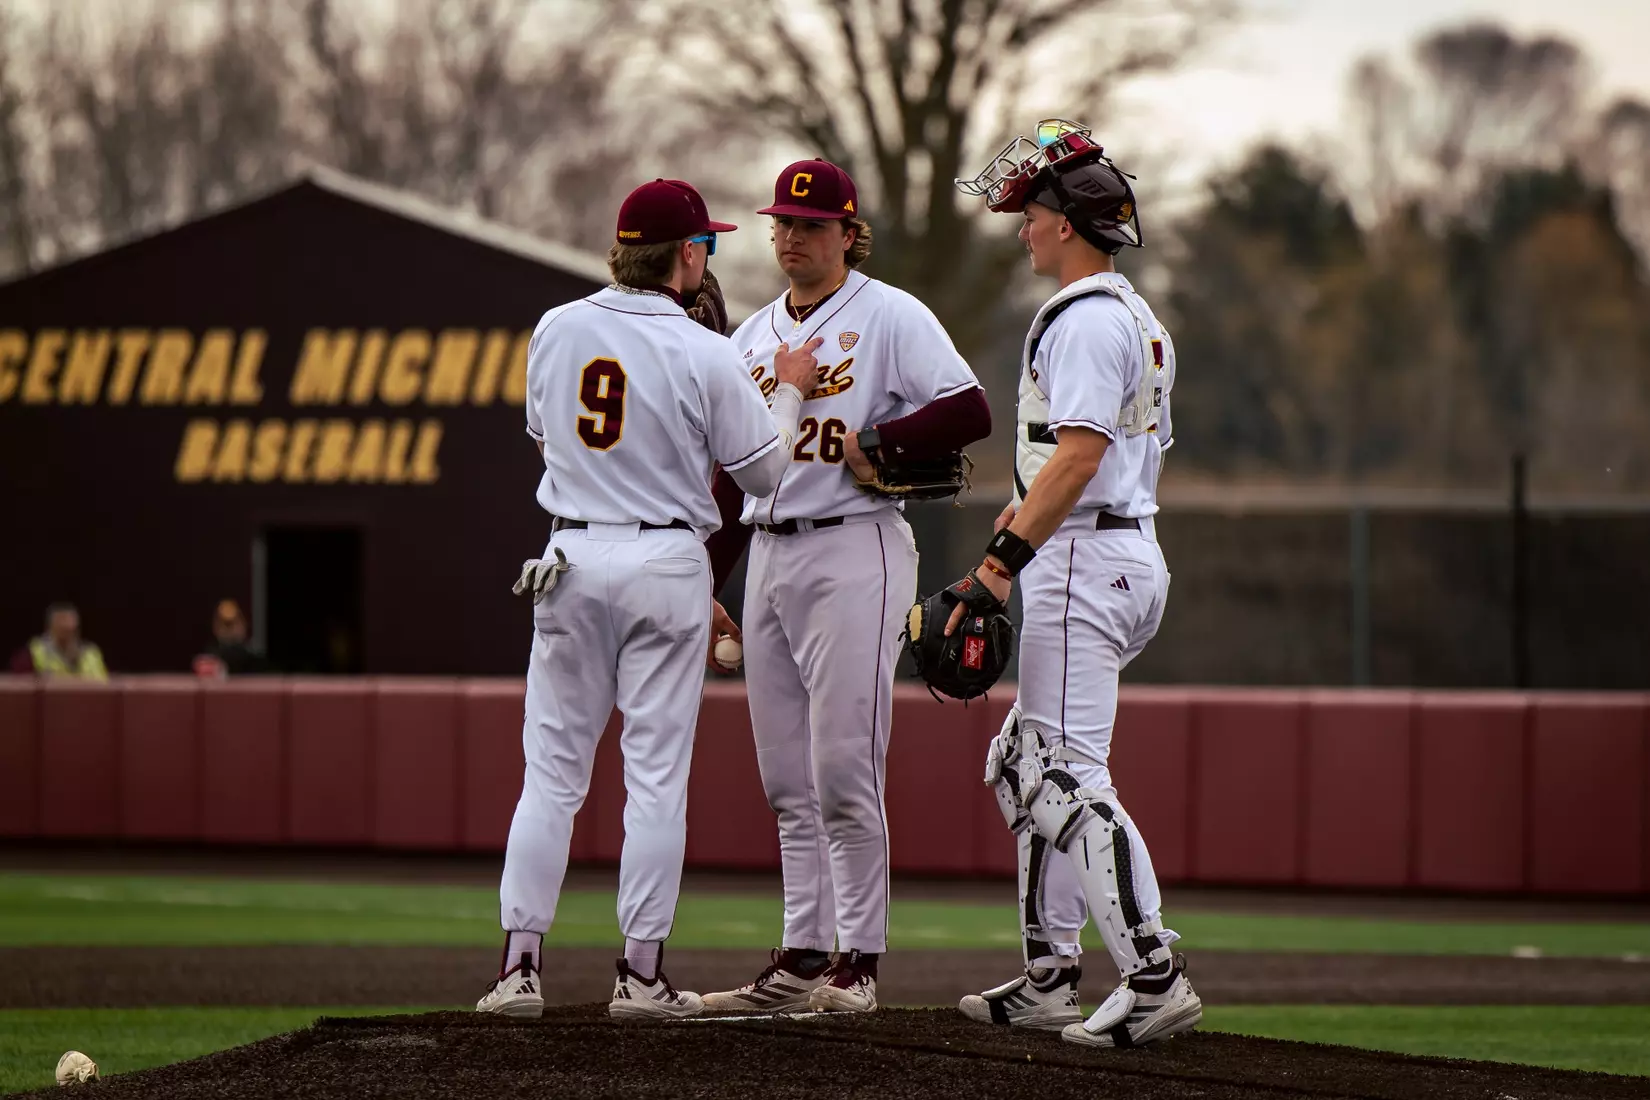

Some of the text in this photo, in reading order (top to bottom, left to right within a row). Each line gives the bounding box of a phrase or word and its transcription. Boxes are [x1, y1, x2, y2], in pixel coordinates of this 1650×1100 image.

[791, 172, 812, 197] C
[0, 328, 268, 404] CENTRAL
[576, 355, 628, 452] 9
[174, 419, 443, 482] BASEBALL
[793, 416, 846, 465] 26
